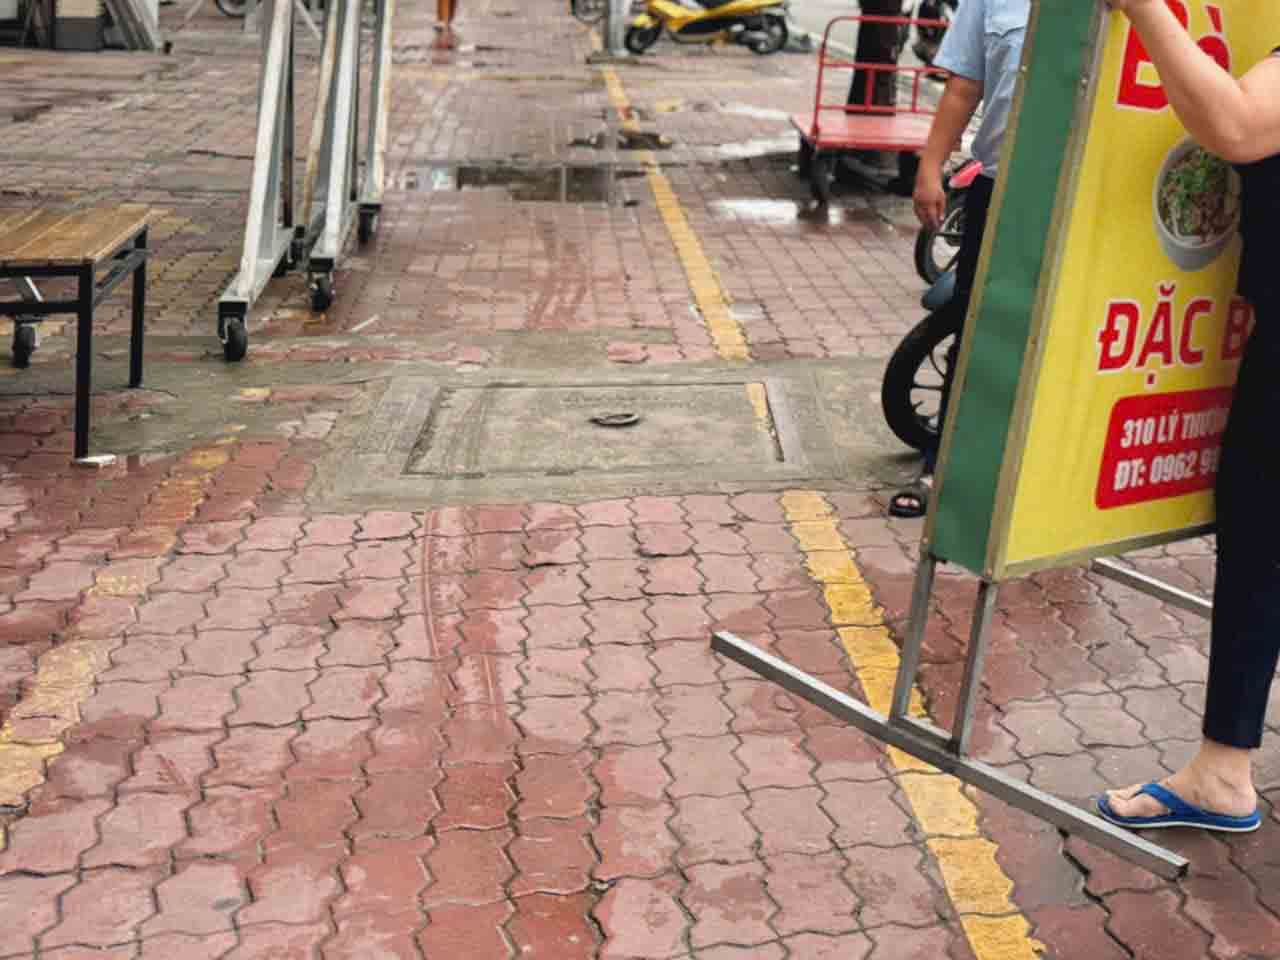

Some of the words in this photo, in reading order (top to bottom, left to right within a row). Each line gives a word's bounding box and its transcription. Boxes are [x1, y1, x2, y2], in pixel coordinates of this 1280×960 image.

[1097, 283, 1215, 386] ĐẶC
[1120, 417, 1155, 448] 310
[1156, 409, 1179, 444] LÝ
[1149, 450, 1199, 484] 0962
